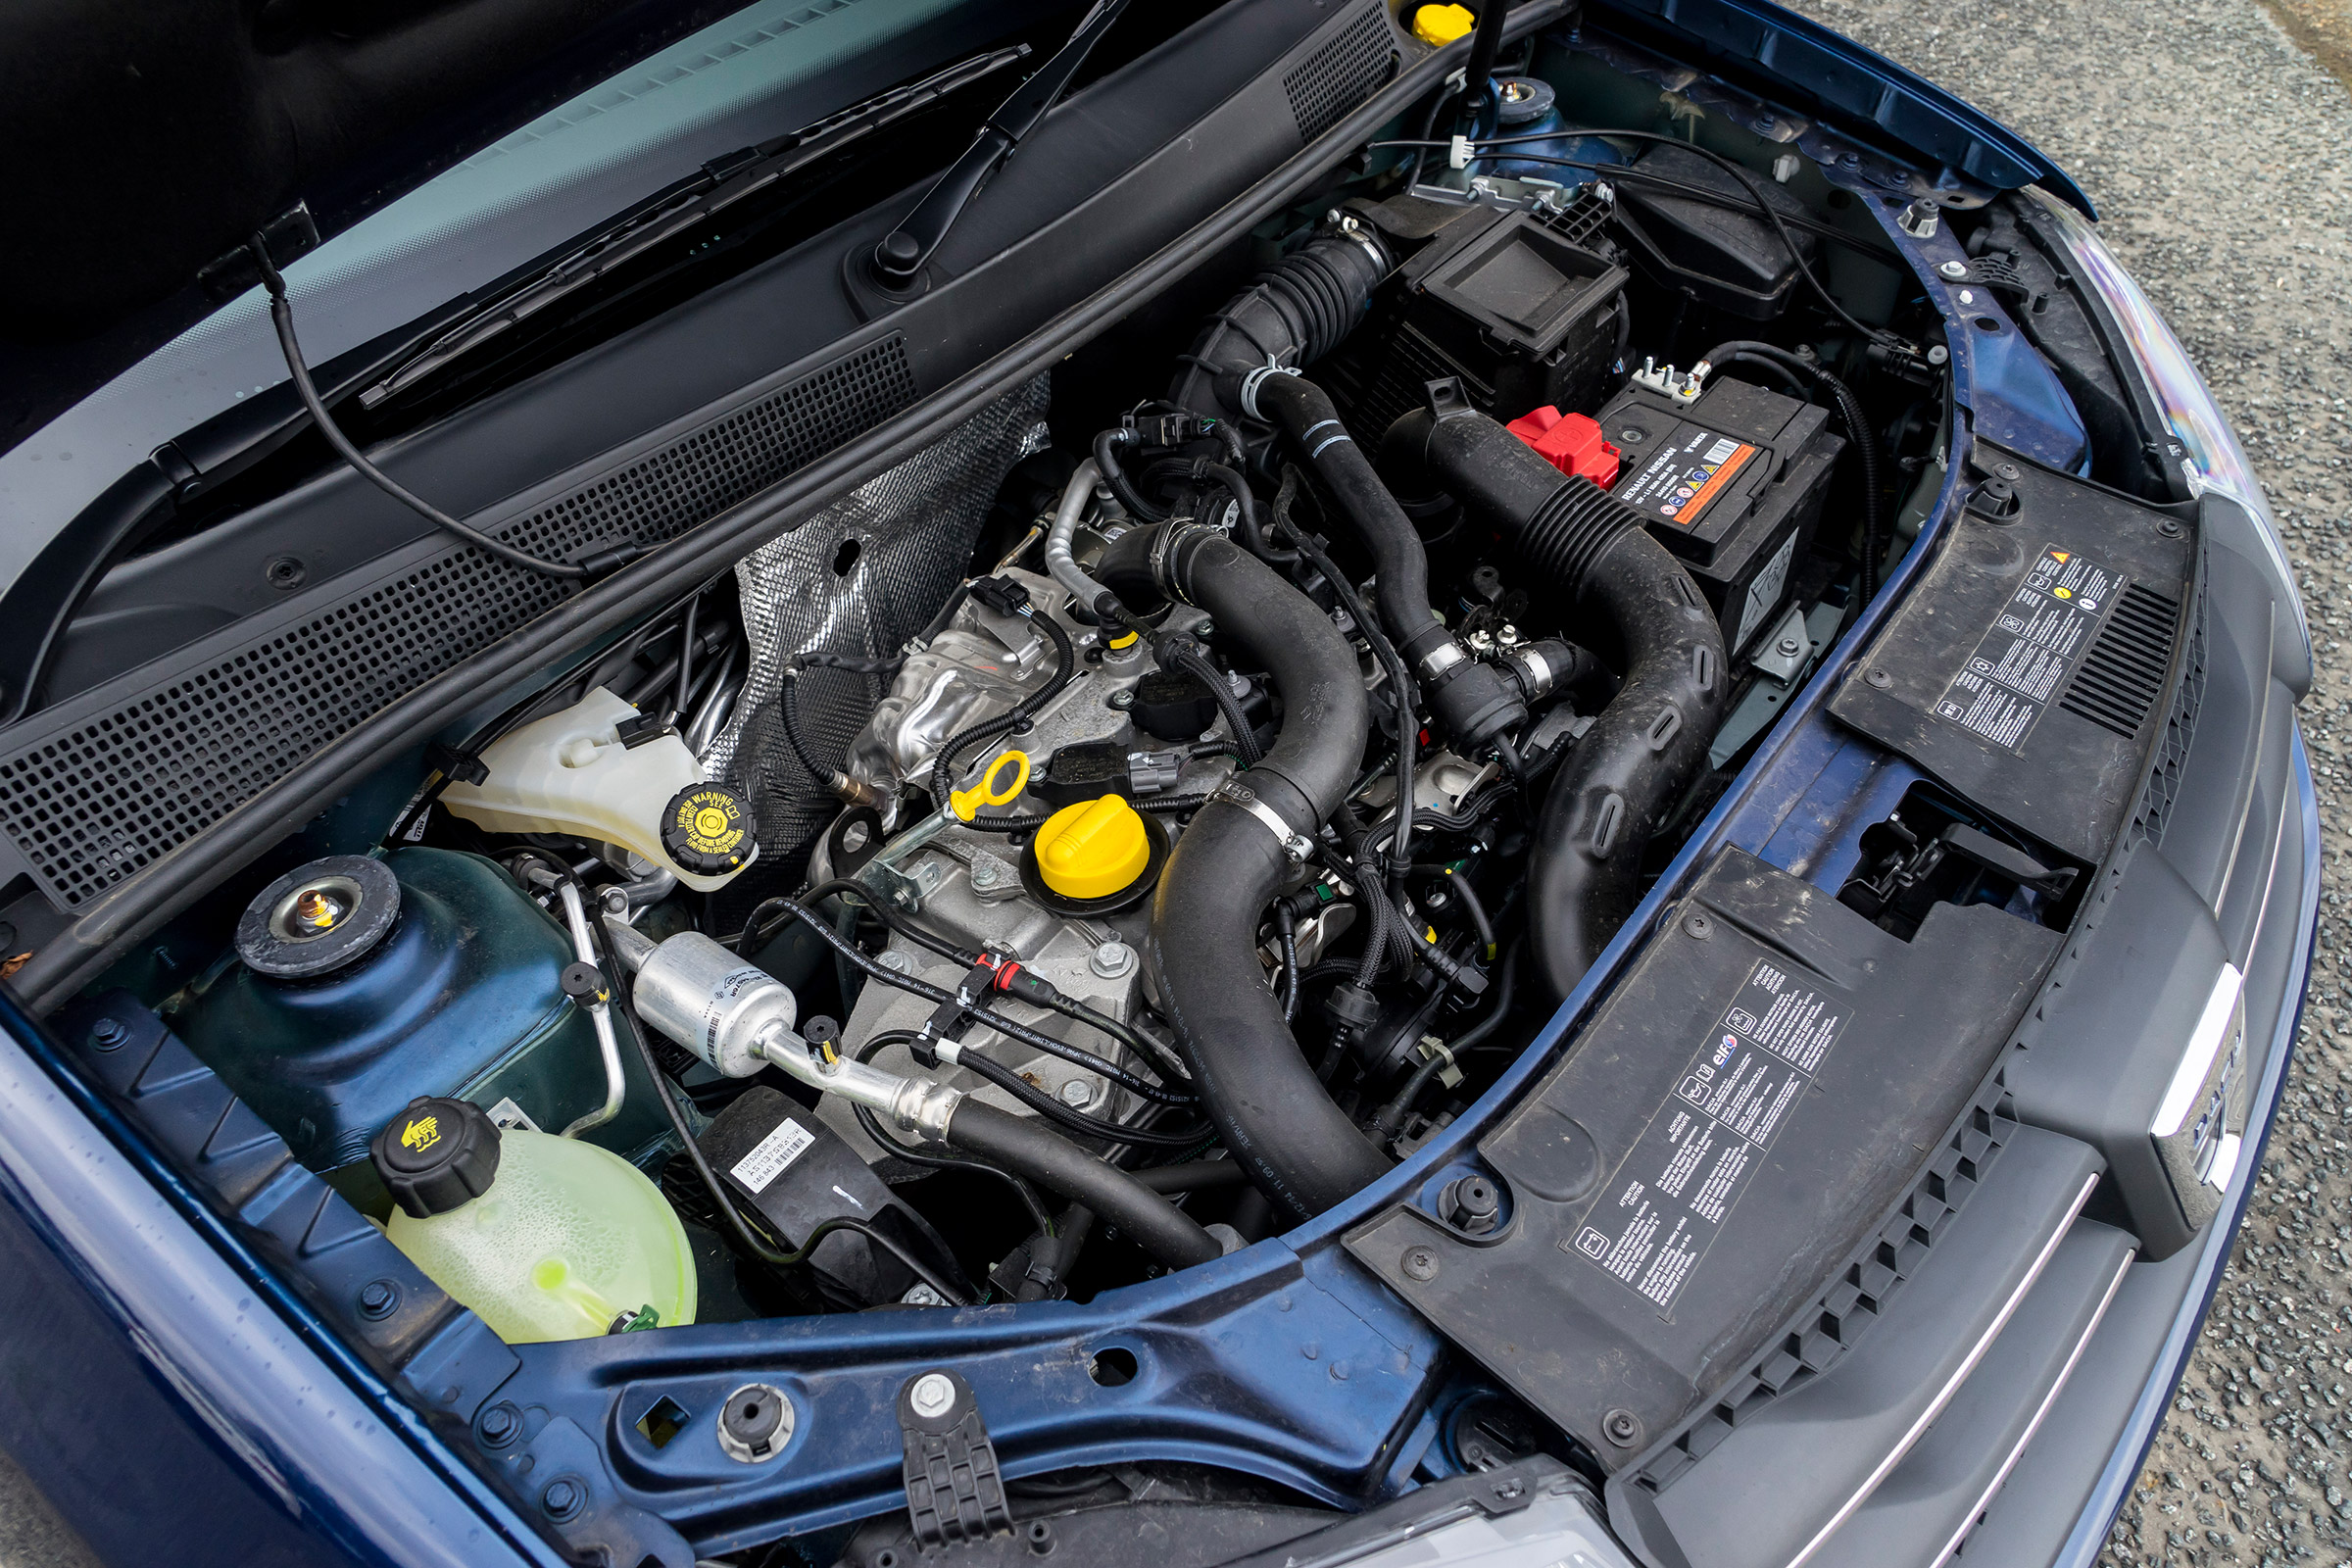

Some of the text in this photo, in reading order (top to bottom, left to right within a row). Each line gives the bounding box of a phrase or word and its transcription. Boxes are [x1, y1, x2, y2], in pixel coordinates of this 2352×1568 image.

[1688, 431, 1708, 448] VARTA
[1620, 471, 1651, 501] RENAULT
[1646, 446, 1678, 474] NISSAN
[691, 791, 734, 807] WARNING
[709, 800, 723, 809] SEE
[1750, 963, 1770, 987] ATTENTION
[1759, 966, 1776, 986] CAUTION
[1764, 970, 1781, 991] ACHTUNG
[1709, 1043, 1732, 1067] elf
[1666, 1109, 1686, 1134] ACHTUNG
[1668, 1113, 1691, 1144] IMPORTANTE
[1617, 1179, 1640, 1207] ATTENTION
[1627, 1183, 1645, 1206] CAUTION
